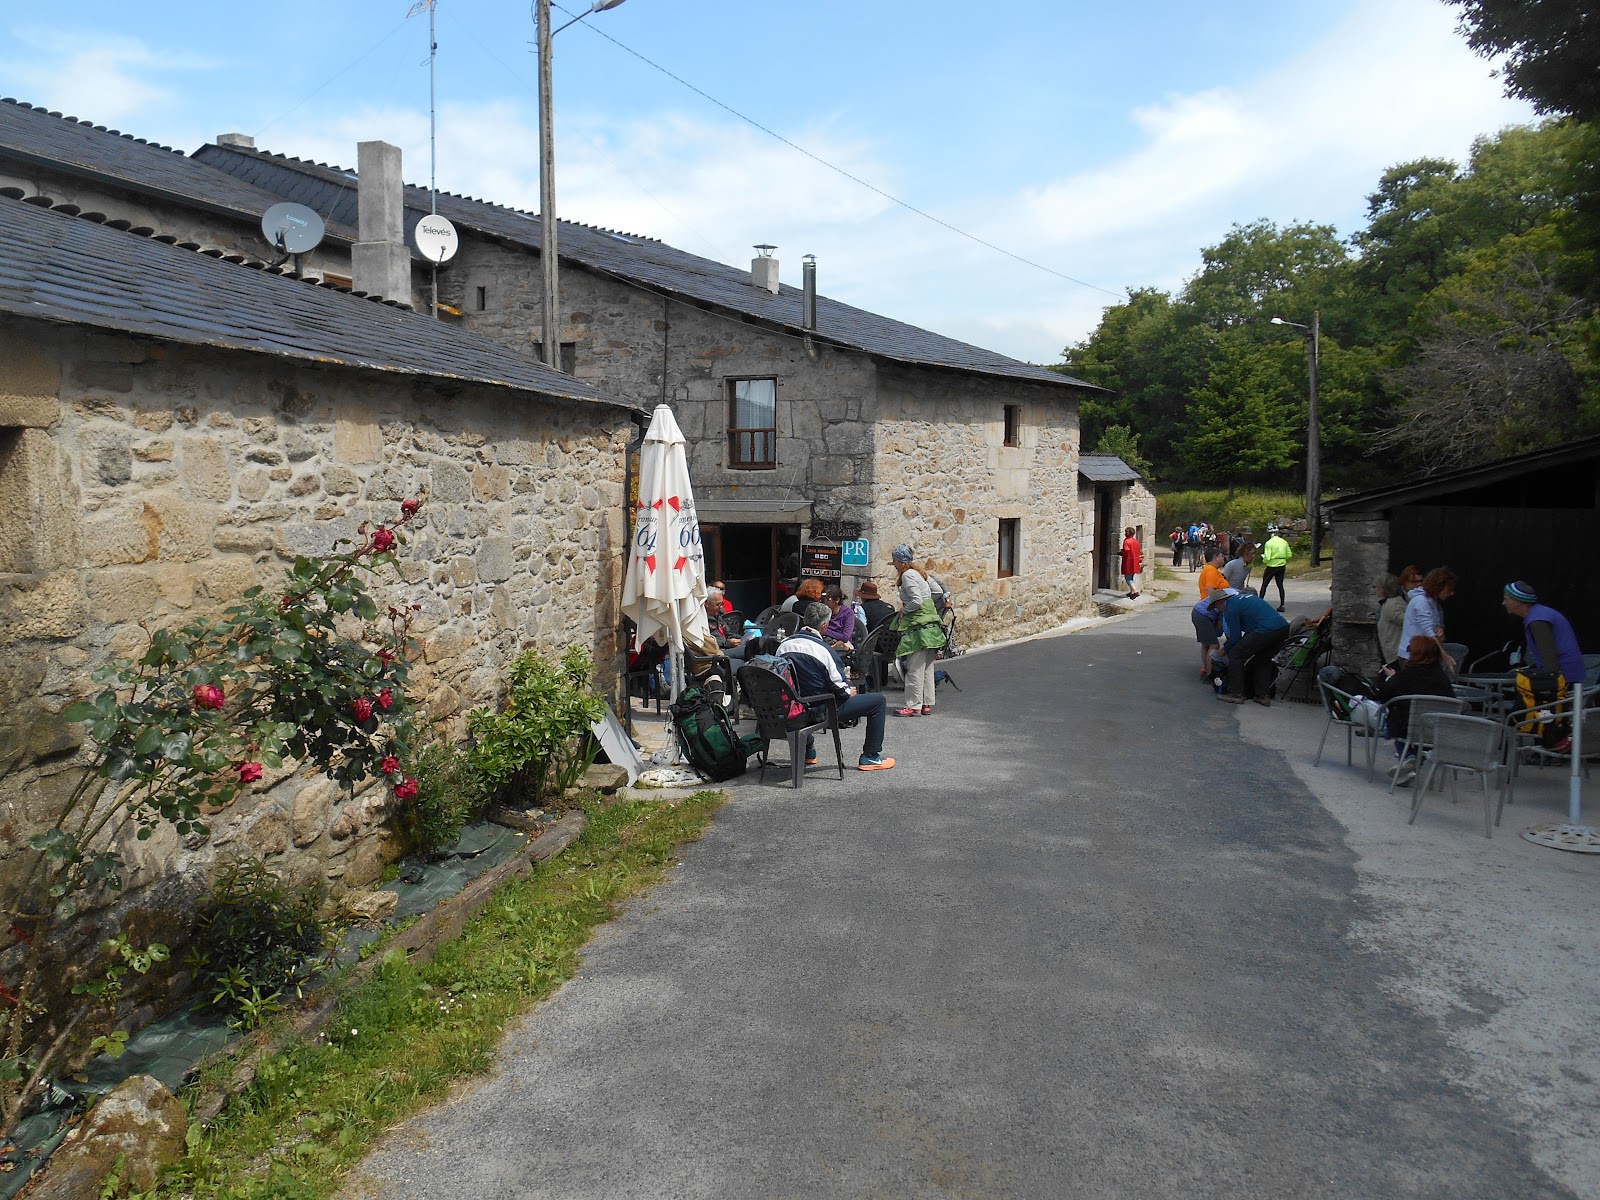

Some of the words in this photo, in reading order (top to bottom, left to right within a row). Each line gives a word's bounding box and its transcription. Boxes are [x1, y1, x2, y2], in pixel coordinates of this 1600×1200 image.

[421, 225, 451, 236] Televés
[823, 522, 844, 530] BAR
[817, 529, 857, 537] MORGADE
[843, 540, 867, 556] PR
